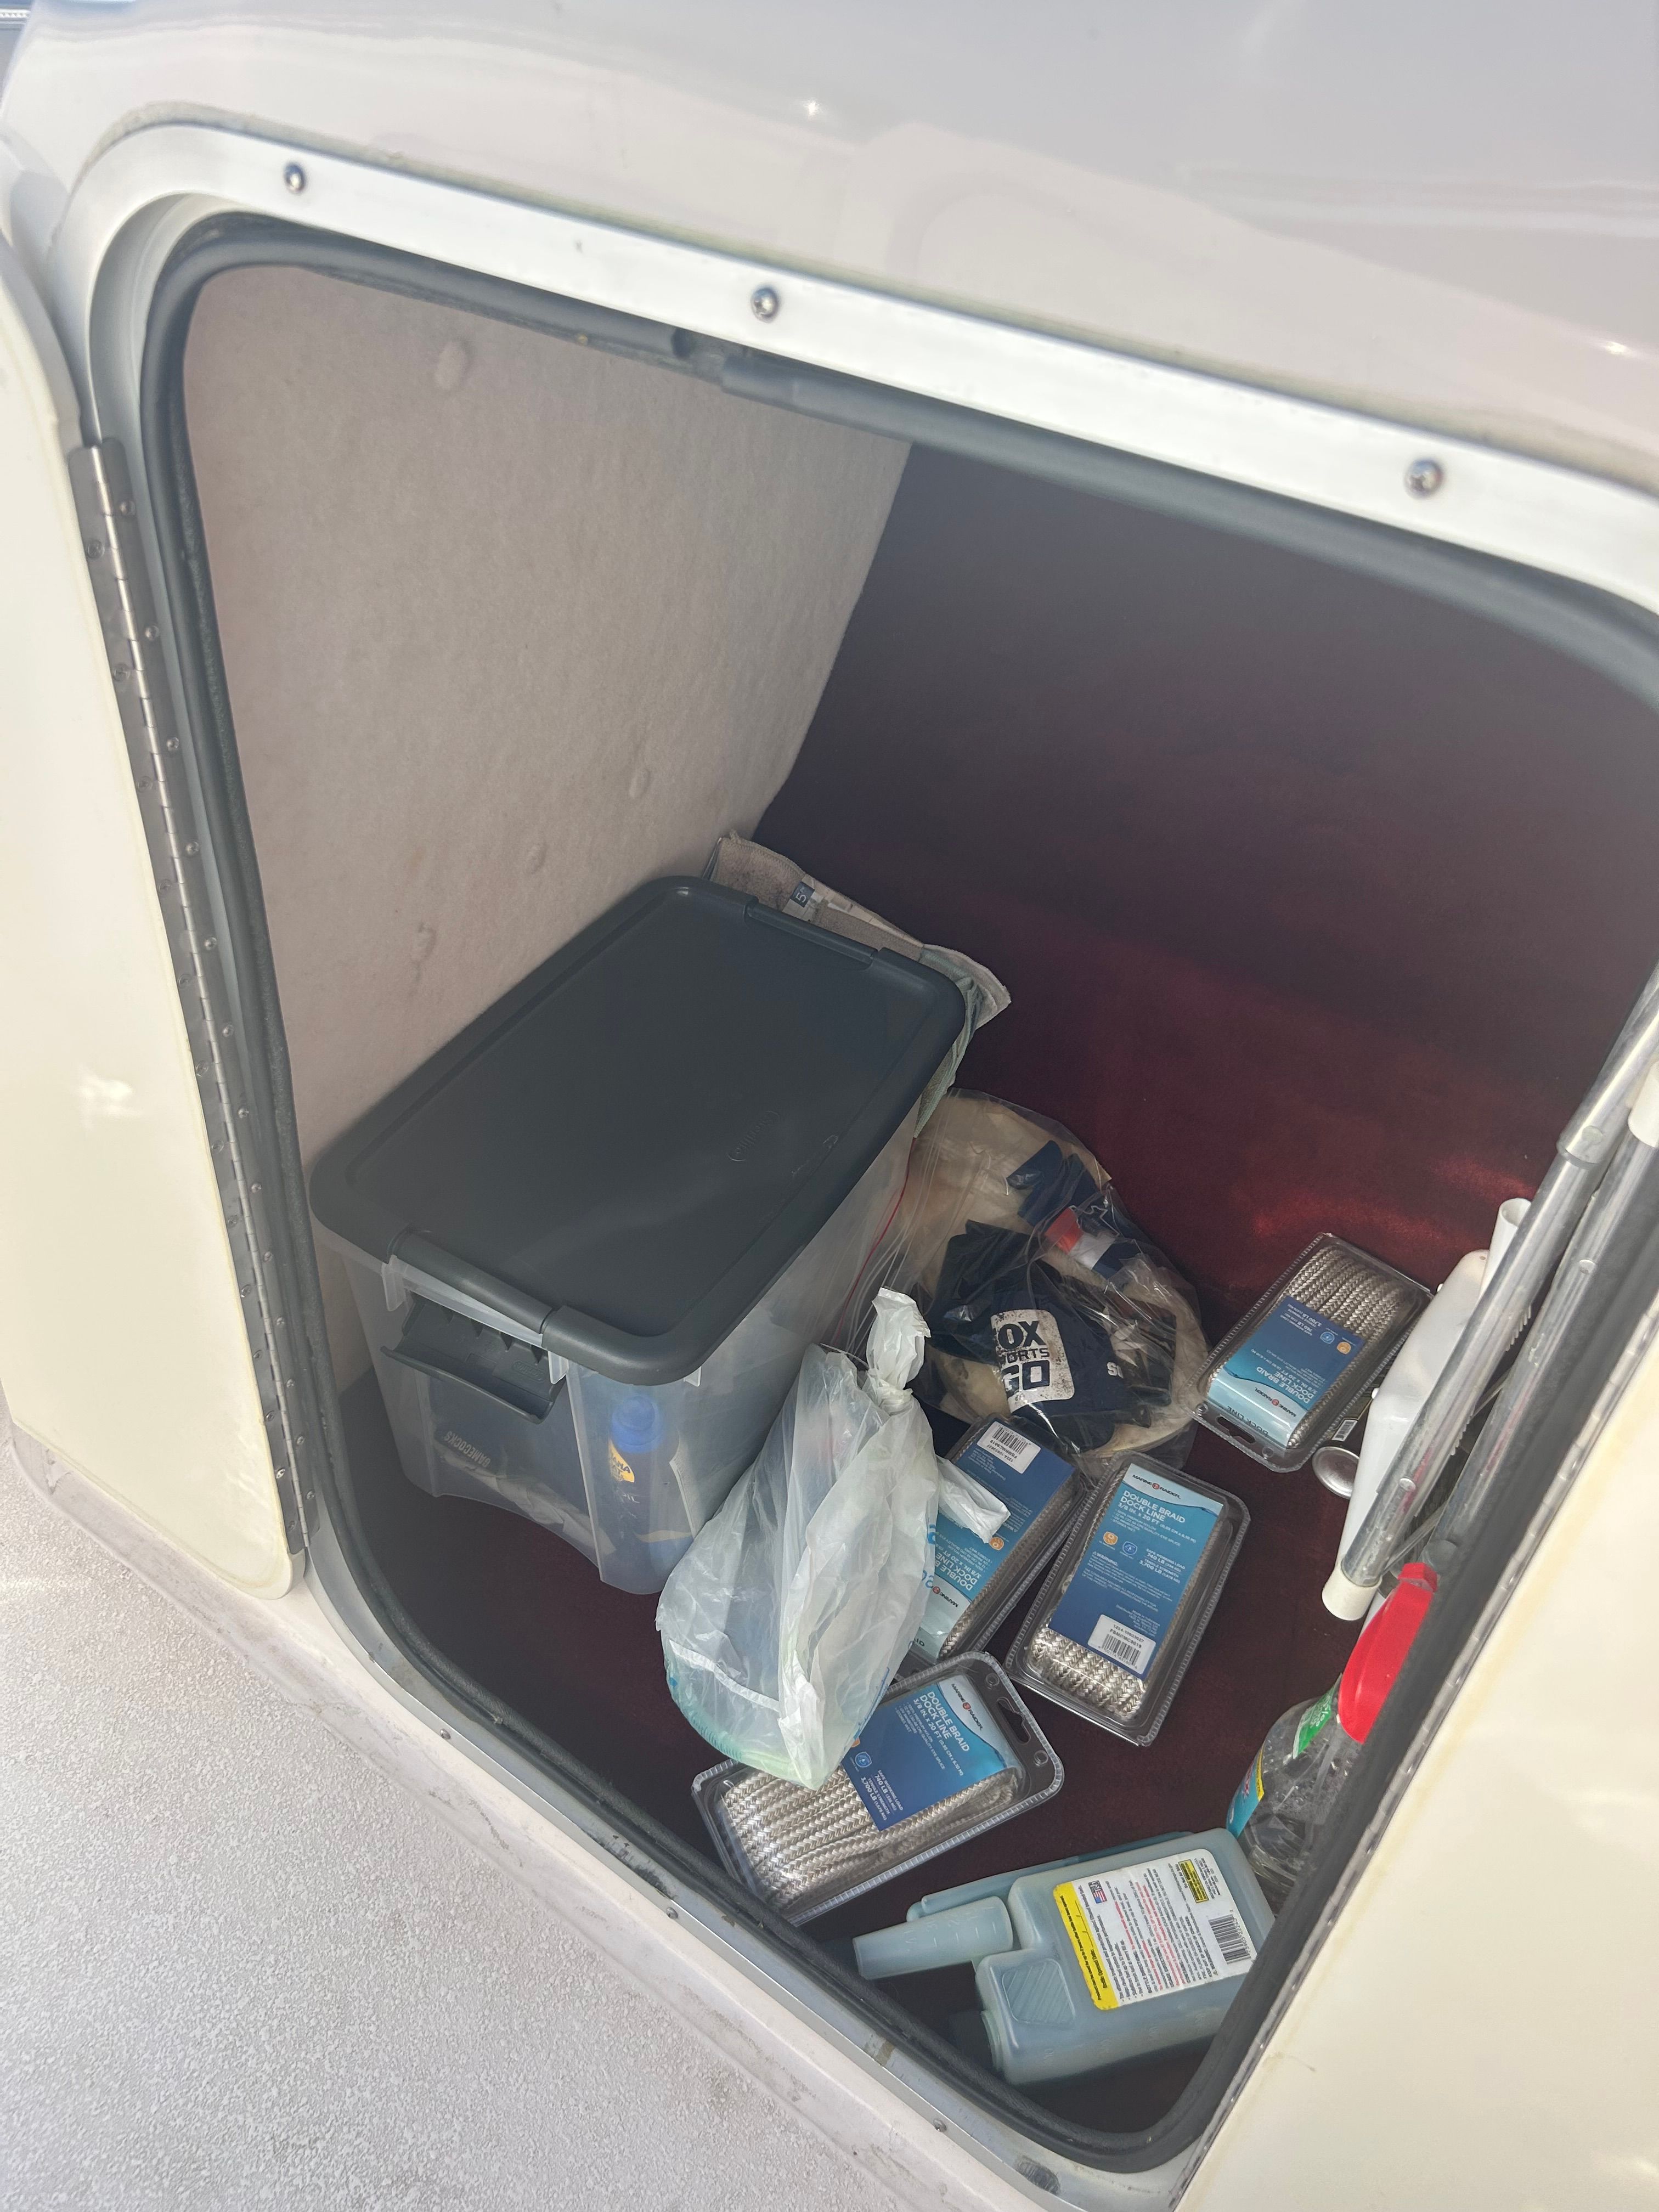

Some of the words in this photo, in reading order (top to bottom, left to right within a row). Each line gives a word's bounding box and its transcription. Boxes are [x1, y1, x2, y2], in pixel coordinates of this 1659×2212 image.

[992, 1321, 1046, 1350] OX
[1256, 1365, 1279, 1384] BRAID
[1274, 1370, 1291, 1385] LINE
[1279, 1381, 1310, 1404] DOUBLE
[1291, 1382, 1313, 1399] DOCK
[443, 1430, 492, 1468] GAMECOCKS
[1132, 1474, 1152, 1485] MARINE
[1159, 1487, 1180, 1498] RAIDER
[1120, 1496, 1146, 1511] DOCK
[1146, 1508, 1166, 1521] LINE
[1123, 1490, 1158, 1510] DOUBLE
[1158, 1507, 1186, 1523] BRAID
[935, 1551, 953, 1568] LINE
[940, 1564, 973, 1591] DOUBLE
[953, 1565, 977, 1585] DOCK
[970, 1569, 981, 1579] 3/8
[913, 1698, 923, 1709] 3/8
[928, 1722, 936, 1730] 20
[919, 1695, 939, 1719] DOCK
[935, 1719, 952, 1739] LINE
[951, 1683, 965, 1702] MARINE
[968, 1709, 983, 1729] RAIDER
[927, 1691, 953, 1725] DOUBLE
[949, 1725, 970, 1752] BRAID
[860, 1776, 873, 1792] 3,700
[870, 1792, 877, 1801] LB
[874, 1774, 884, 1785] 740
[878, 1770, 886, 1780] SAFE
[883, 1780, 898, 1798] WORKING
[894, 1799, 904, 1810] LOAD
[1142, 1976, 1153, 1994] BOTTLE
